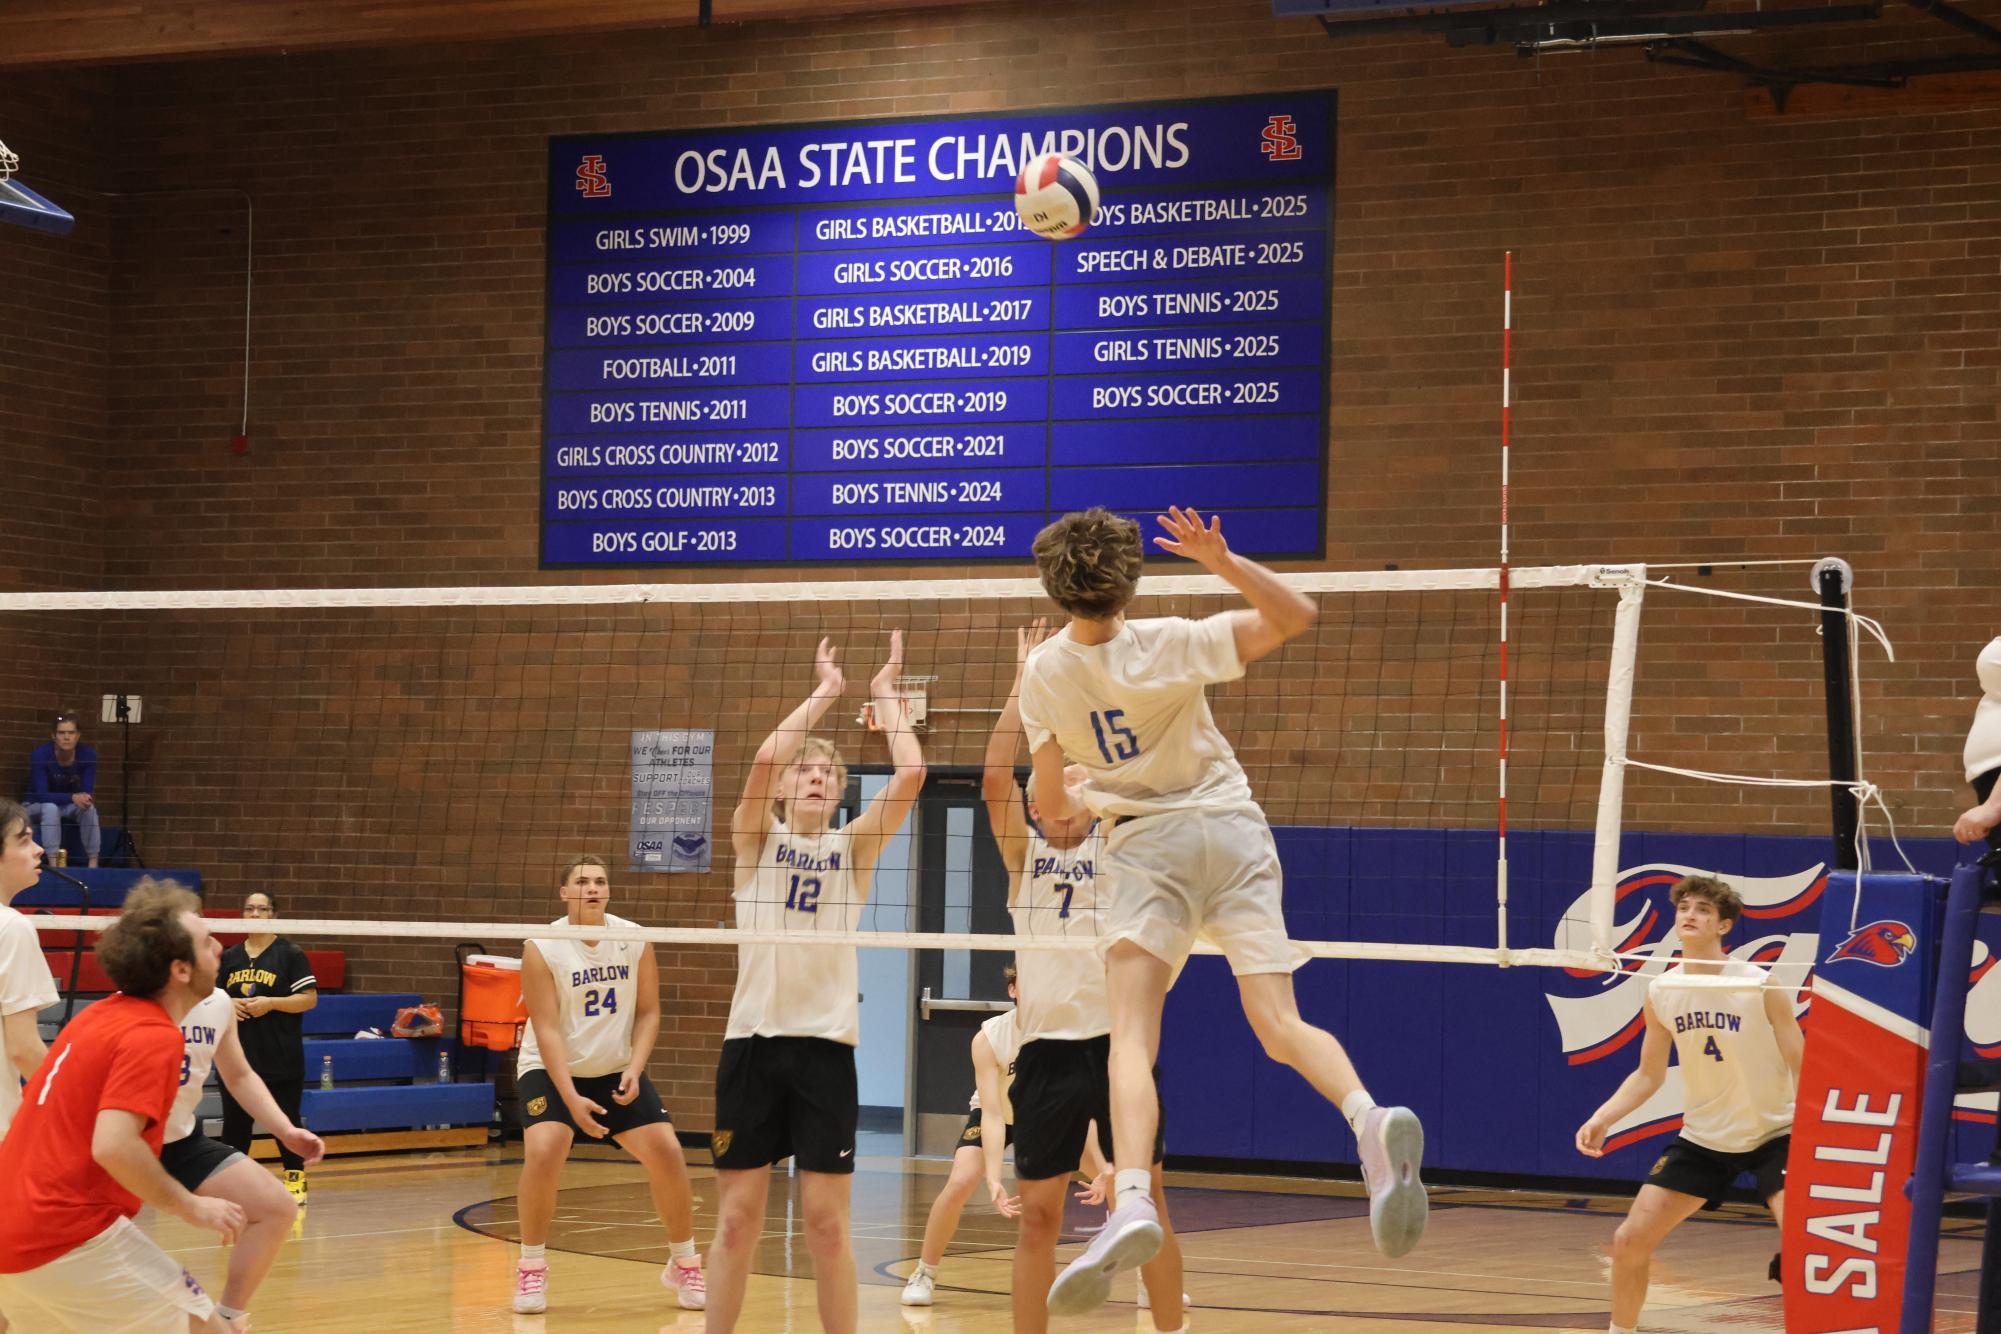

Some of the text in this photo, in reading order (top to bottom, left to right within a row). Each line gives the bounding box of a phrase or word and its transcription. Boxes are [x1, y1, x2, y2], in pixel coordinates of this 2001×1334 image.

[674, 121, 1191, 194] OSAA STATE CHAMPIONS
[815, 217, 868, 241] GIRLS
[872, 210, 1030, 238] BASKETBALL•201
[1087, 203, 1125, 228] OYS
[596, 229, 645, 250] GIRLS
[1076, 249, 1148, 273] SPEECH
[1152, 248, 1168, 270] &
[587, 272, 632, 294] BOYS
[833, 261, 886, 284] GIRLS
[812, 306, 865, 329] GIRLS
[1098, 294, 1148, 318] BOYS
[587, 315, 631, 337] BOYS
[811, 350, 864, 373] GIRLS
[1093, 339, 1149, 362] GIRLS
[832, 394, 881, 417] BOYS
[1092, 385, 1143, 409] BOYS
[590, 402, 635, 423] BOYS
[557, 446, 601, 467] GIRLS
[605, 444, 656, 466] CROSS
[832, 438, 880, 460] BOYS
[558, 489, 598, 510] BOYS
[601, 488, 653, 509] CROSS
[832, 483, 880, 505] BOYS
[592, 532, 638, 553] BOYS
[829, 527, 877, 549] BOYS
[1090, 709, 1140, 764] 15
[672, 745, 690, 755] FOR
[692, 745, 711, 755] OUR
[633, 773, 678, 783] SUPPORT
[785, 874, 822, 913] 12
[1054, 883, 1074, 918] 7
[572, 965, 629, 987] BARLOW
[584, 987, 617, 1017] 24
[1674, 1011, 1741, 1034] BARLOW
[1703, 1035, 1724, 1062] 4
[1804, 1088, 1903, 1299] SALLE
